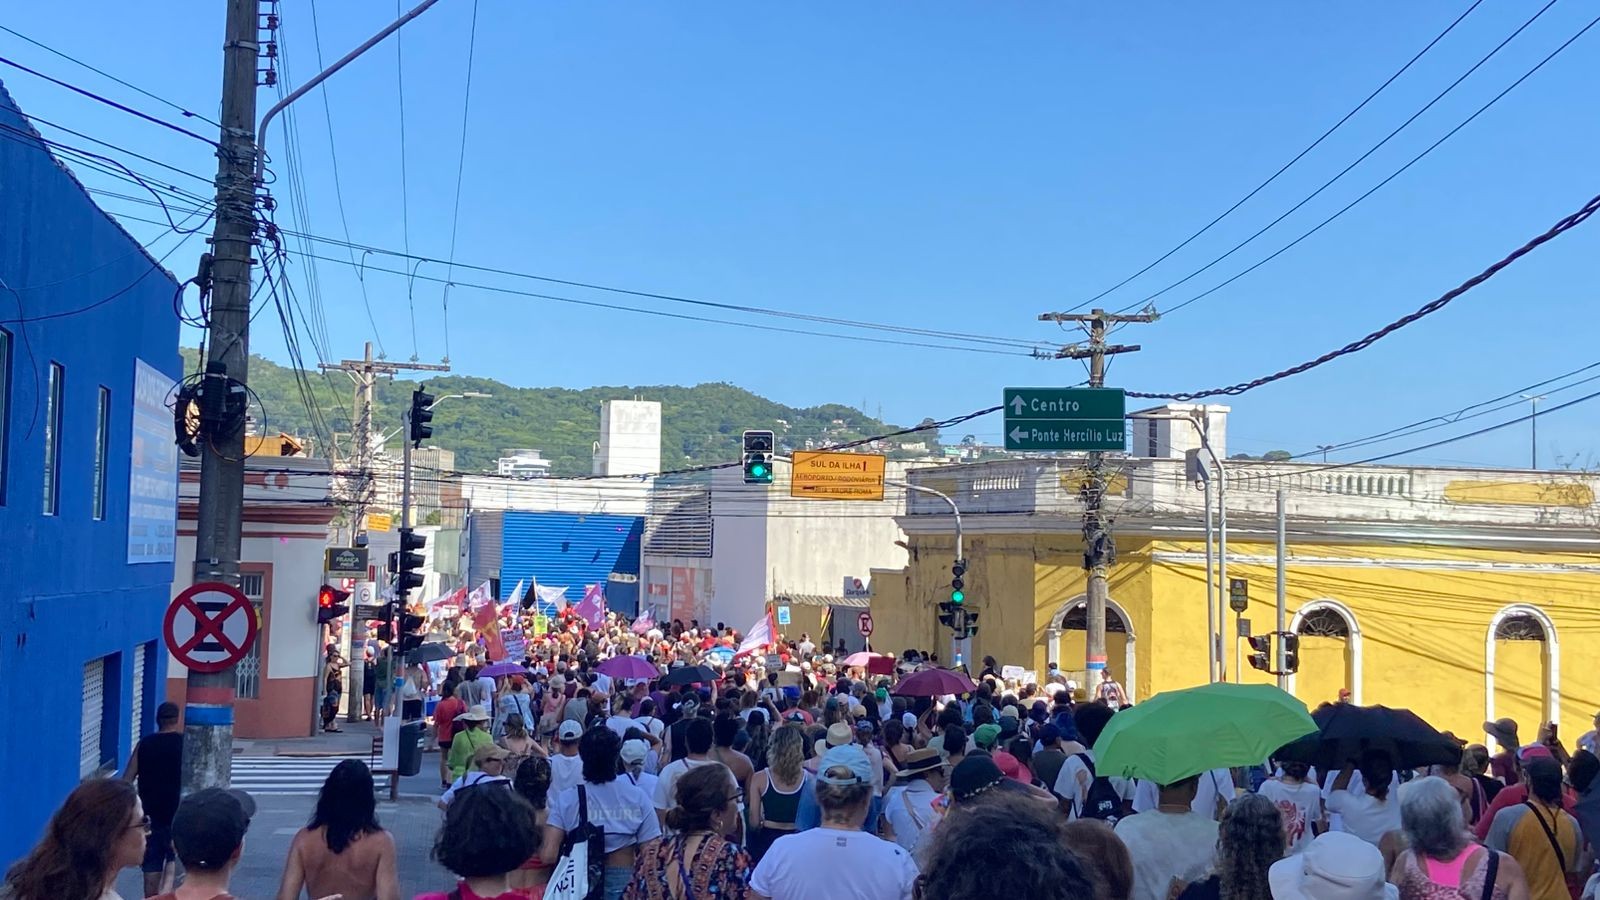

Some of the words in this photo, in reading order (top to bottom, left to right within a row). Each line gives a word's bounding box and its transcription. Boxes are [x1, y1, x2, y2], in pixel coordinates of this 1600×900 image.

[1031, 398, 1080, 411] Centro
[1031, 429, 1060, 442] Ponte
[1063, 428, 1102, 442] Hercílio
[1106, 429, 1124, 442] Luz
[810, 460, 827, 468] SUL
[829, 461, 840, 469] DA
[842, 462, 861, 470] ILHA
